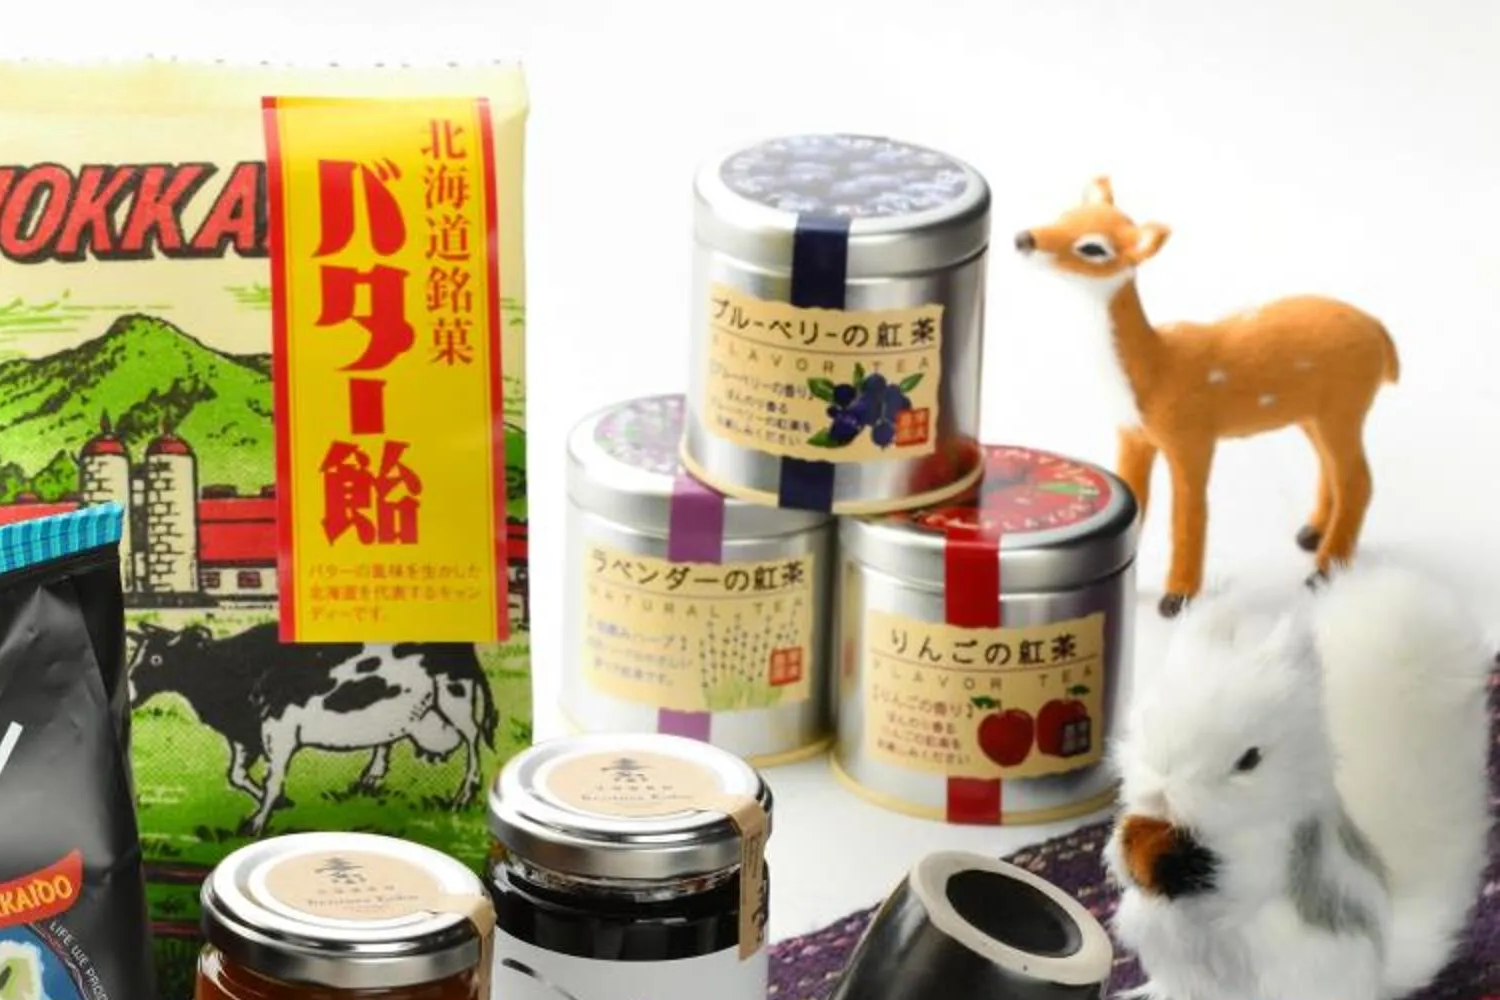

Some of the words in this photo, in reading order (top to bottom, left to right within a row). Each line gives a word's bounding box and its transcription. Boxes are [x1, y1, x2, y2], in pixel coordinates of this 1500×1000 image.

[420, 117, 476, 366] 北海道銘菓
[311, 156, 422, 546] バター飴
[592, 549, 804, 591] ラベンダーの紅茶
[892, 629, 1077, 665] りんごの紅茶
